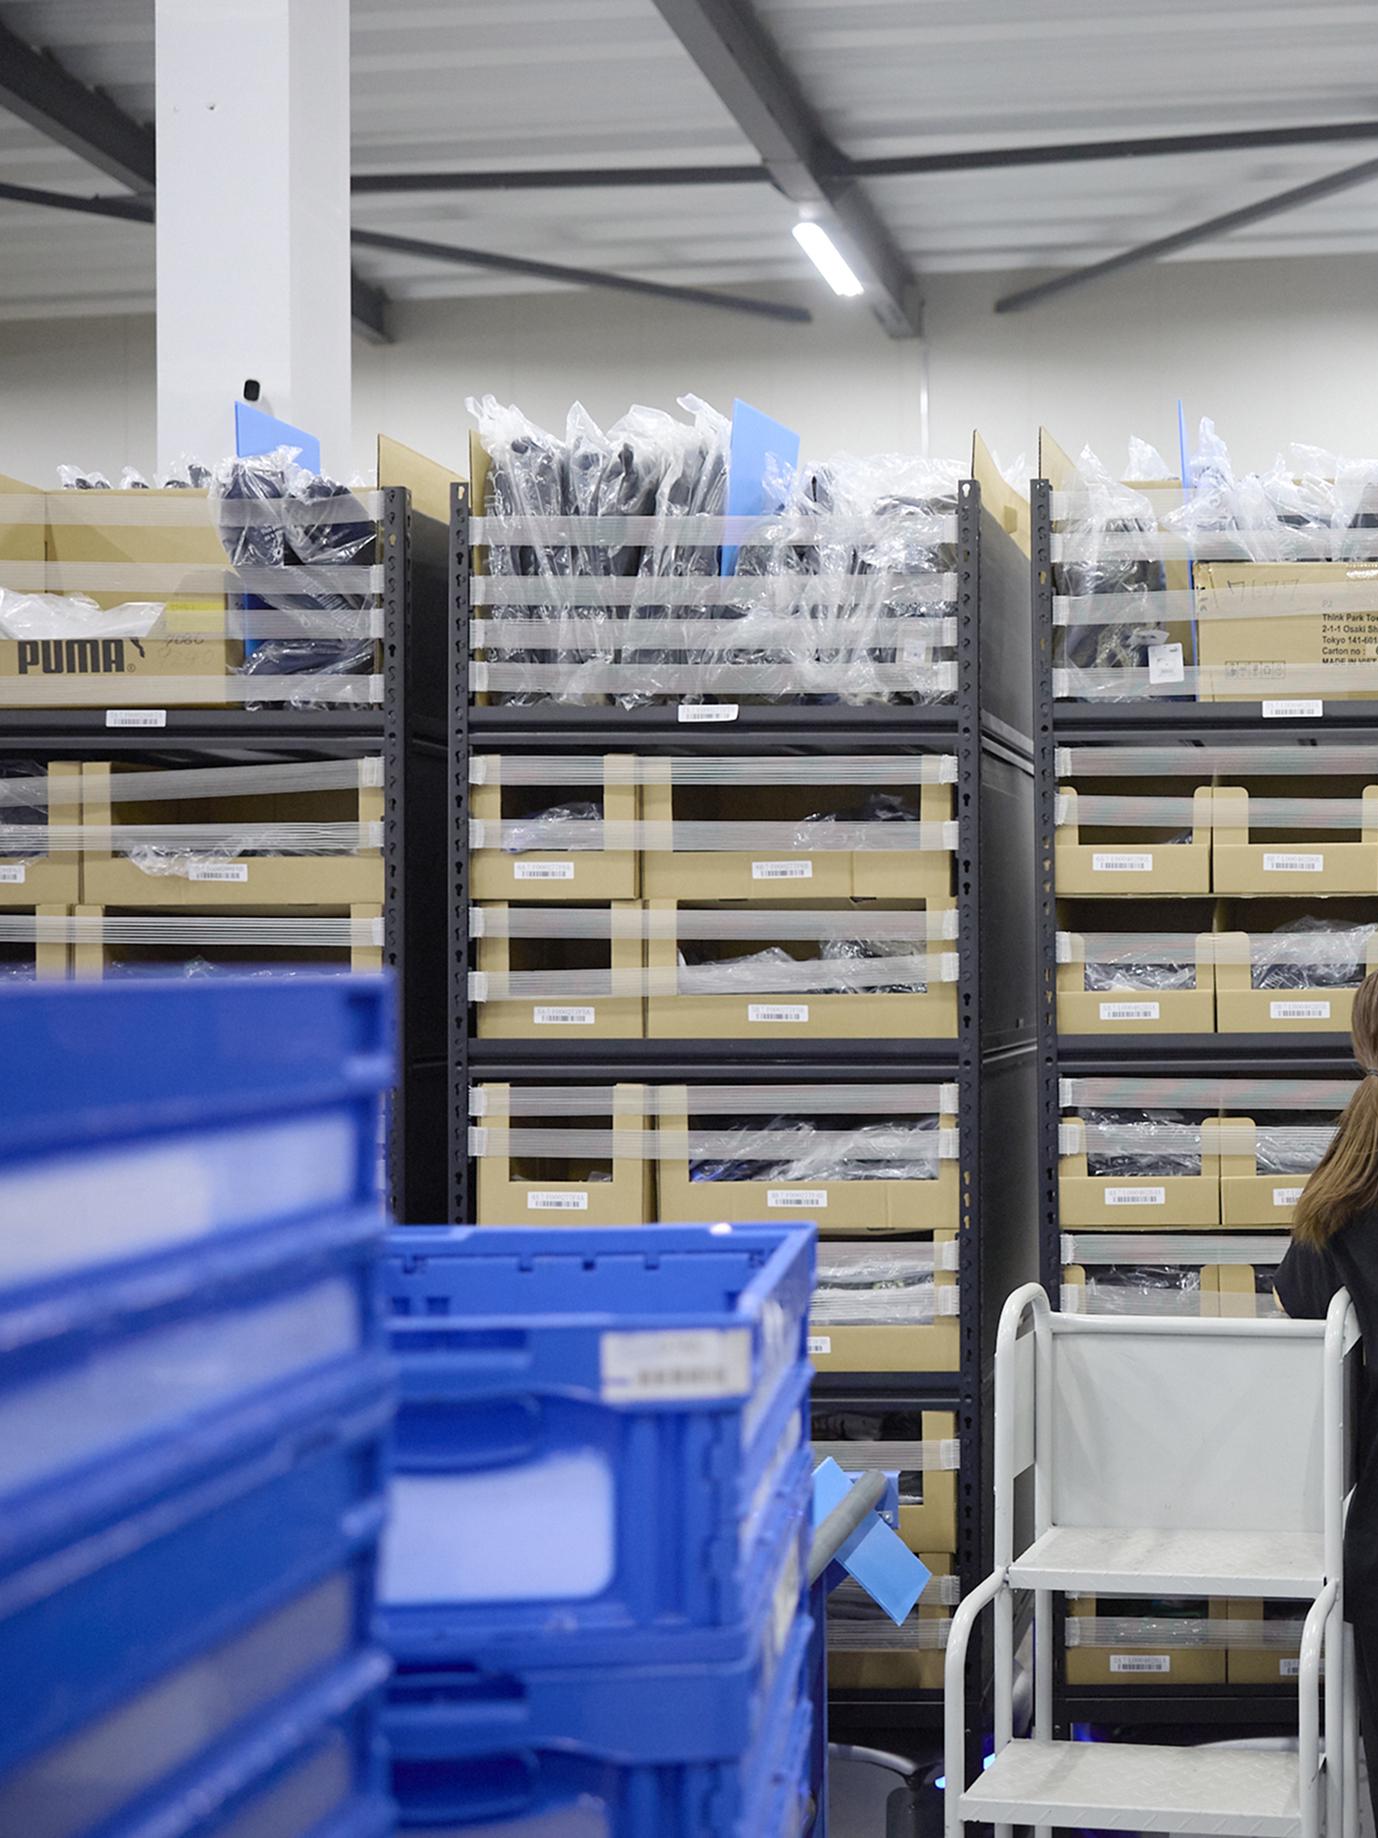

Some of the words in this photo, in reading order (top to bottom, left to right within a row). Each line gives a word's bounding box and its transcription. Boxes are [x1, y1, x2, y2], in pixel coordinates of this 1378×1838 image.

[1322, 613, 1344, 621] Think
[1346, 613, 1364, 621] Park
[1322, 625, 1341, 633] 2-1-1
[1343, 625, 1366, 633] Osaki
[1322, 636, 1346, 645] Tokyo
[1322, 647, 1349, 655] Carton
[18, 638, 125, 674] PUMA
